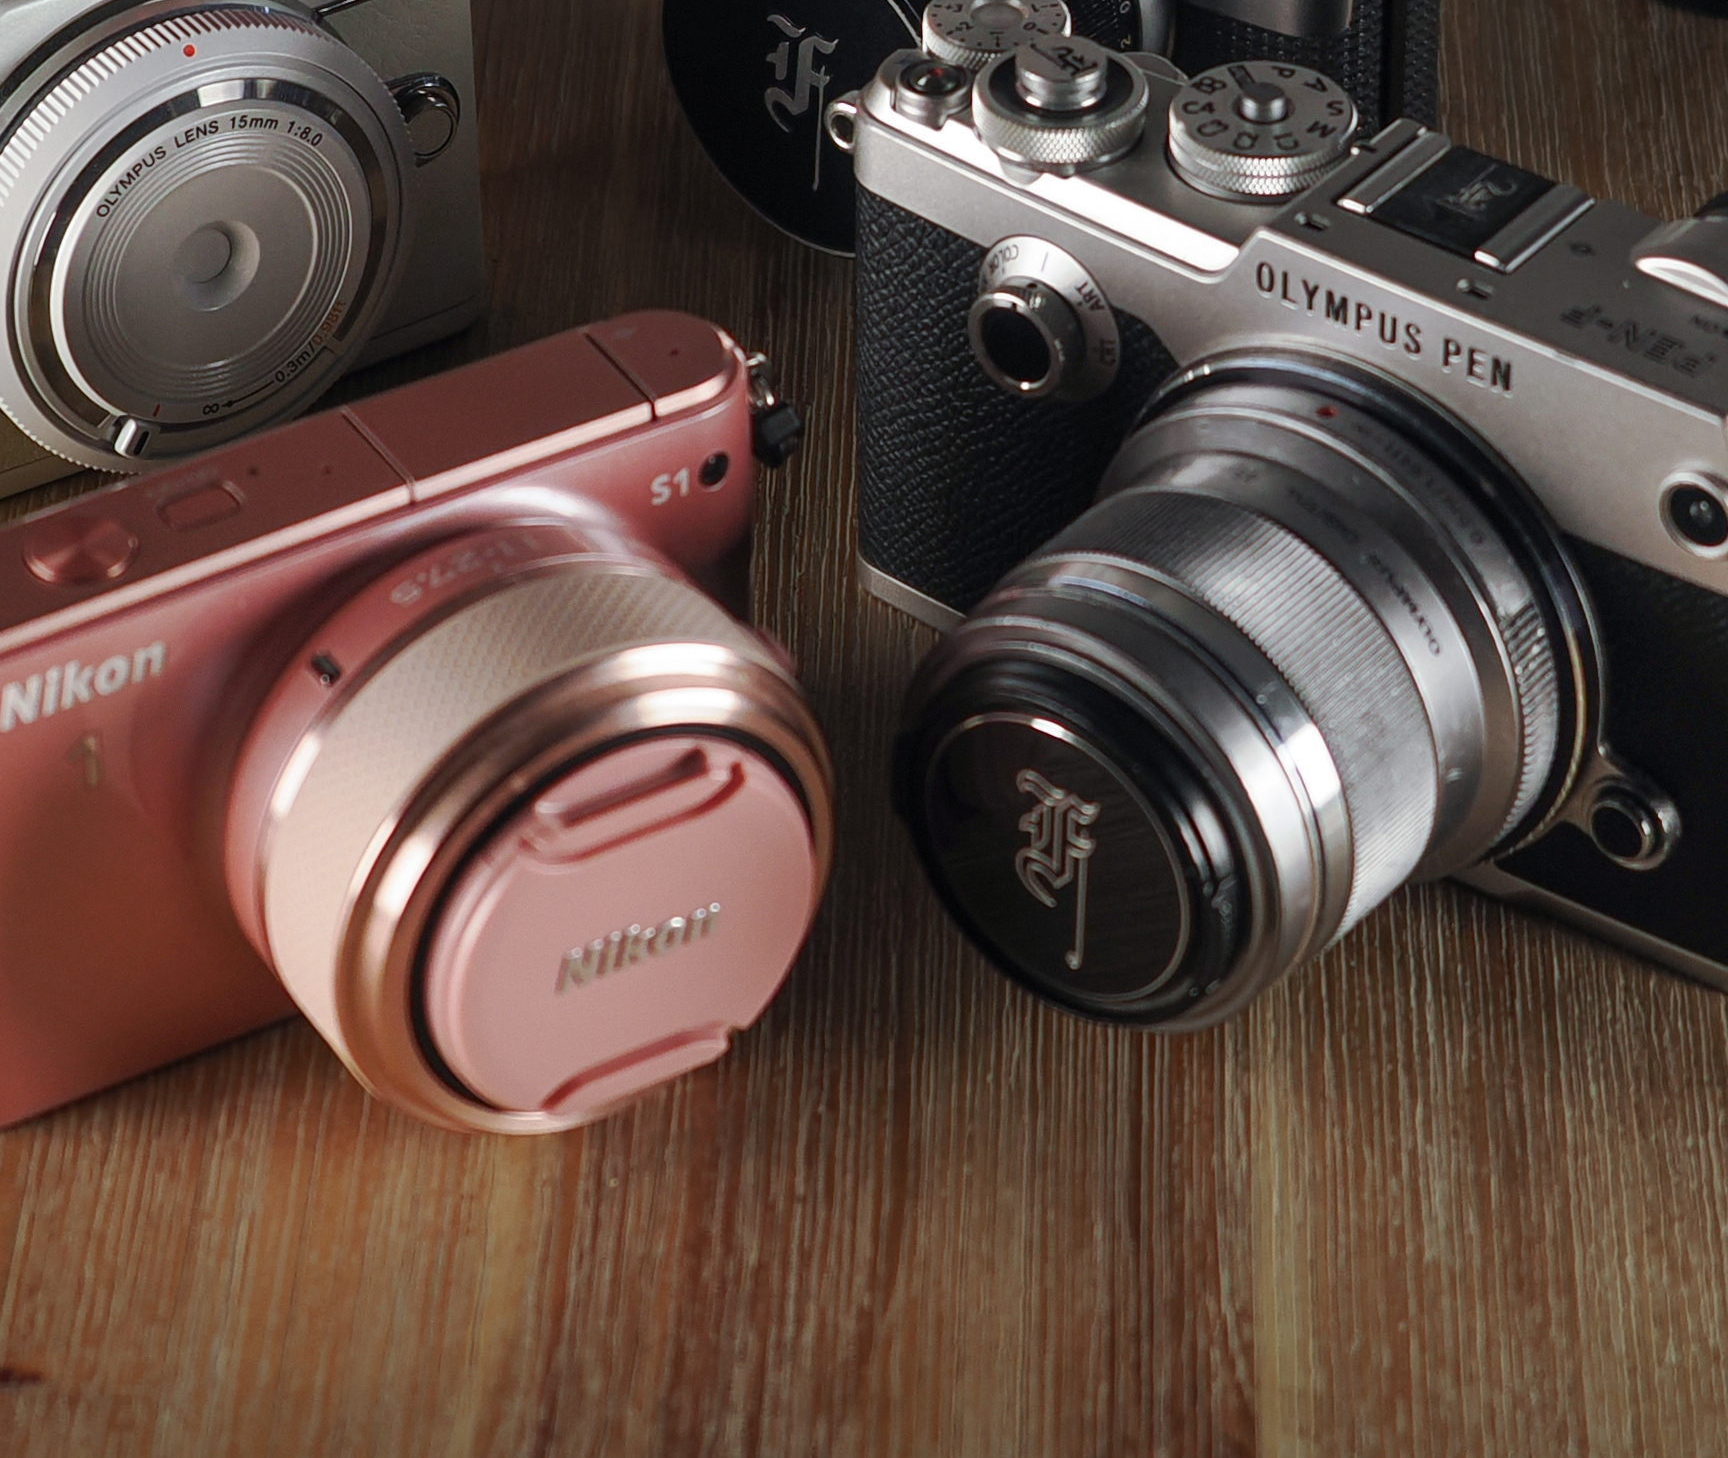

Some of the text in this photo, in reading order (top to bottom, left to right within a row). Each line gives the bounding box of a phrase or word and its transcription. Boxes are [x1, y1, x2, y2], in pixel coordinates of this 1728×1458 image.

[96, 114, 323, 218] OLYMPUS LENS 15mm 1:8.0
[1255, 260, 1514, 394] OLYMPUS PEN
[650, 468, 690, 506] S1
[554, 902, 722, 996] Nikon
